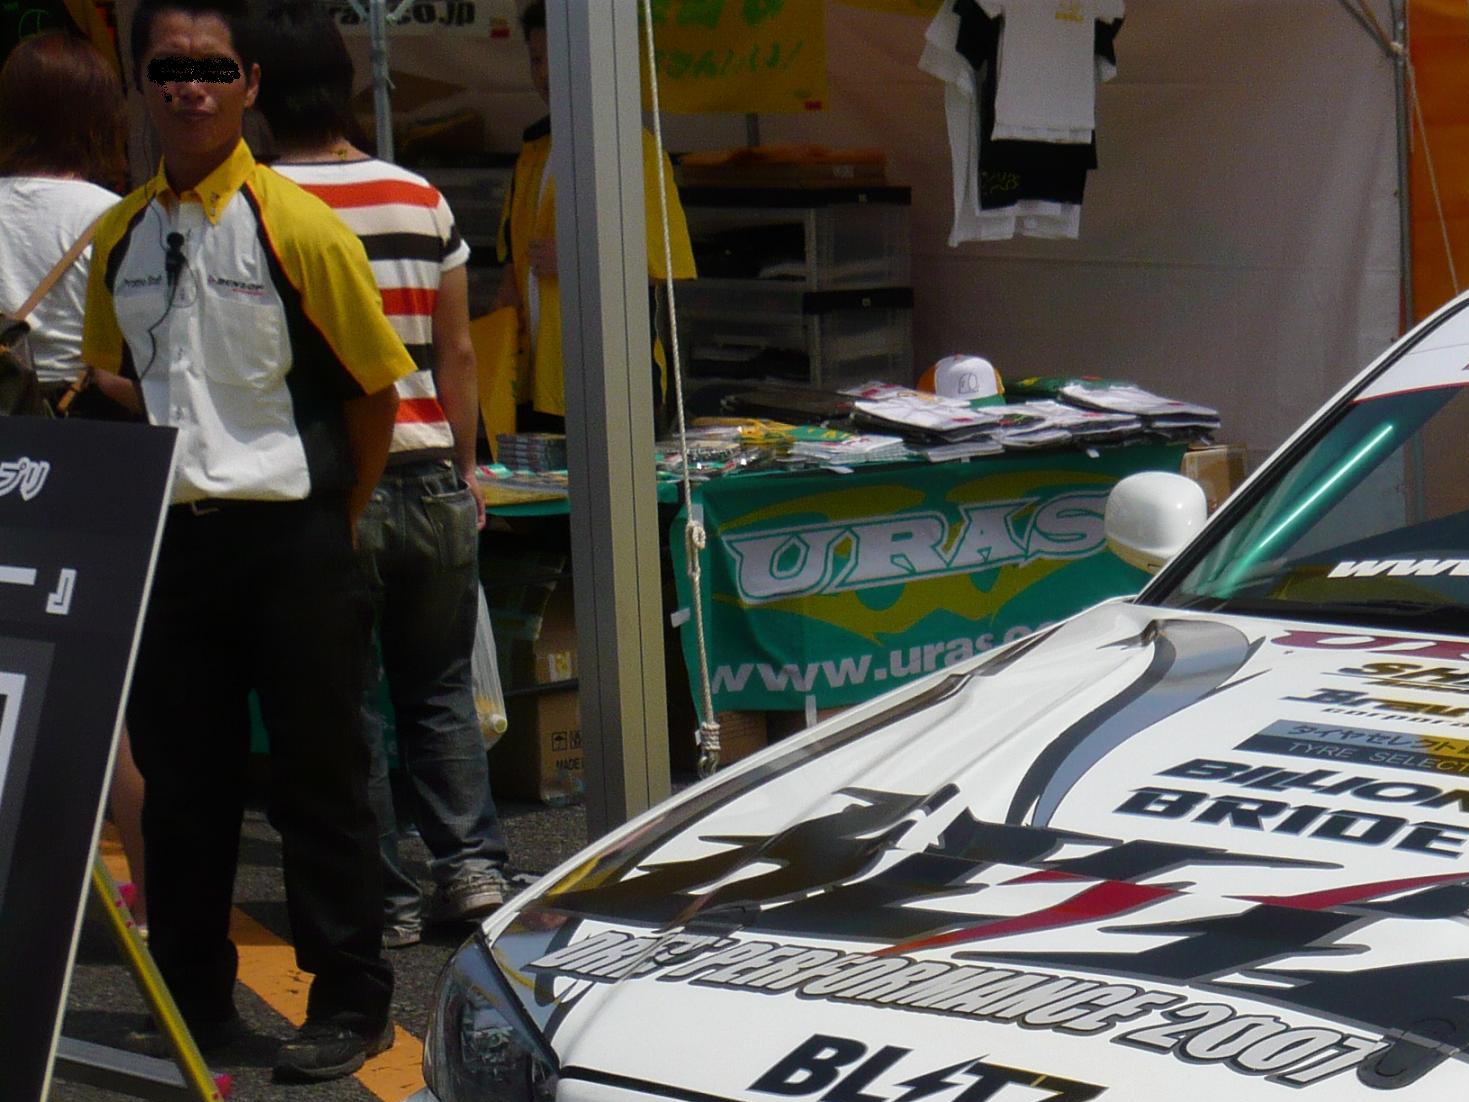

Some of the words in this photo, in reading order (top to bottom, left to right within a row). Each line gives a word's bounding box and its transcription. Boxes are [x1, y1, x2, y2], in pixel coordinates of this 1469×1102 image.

[722, 490, 1107, 604] URAS
[1287, 742, 1358, 760] TYRE
[688, 938, 1189, 1037] PERFORMANCE
[1110, 1002, 1391, 1090] 2007
